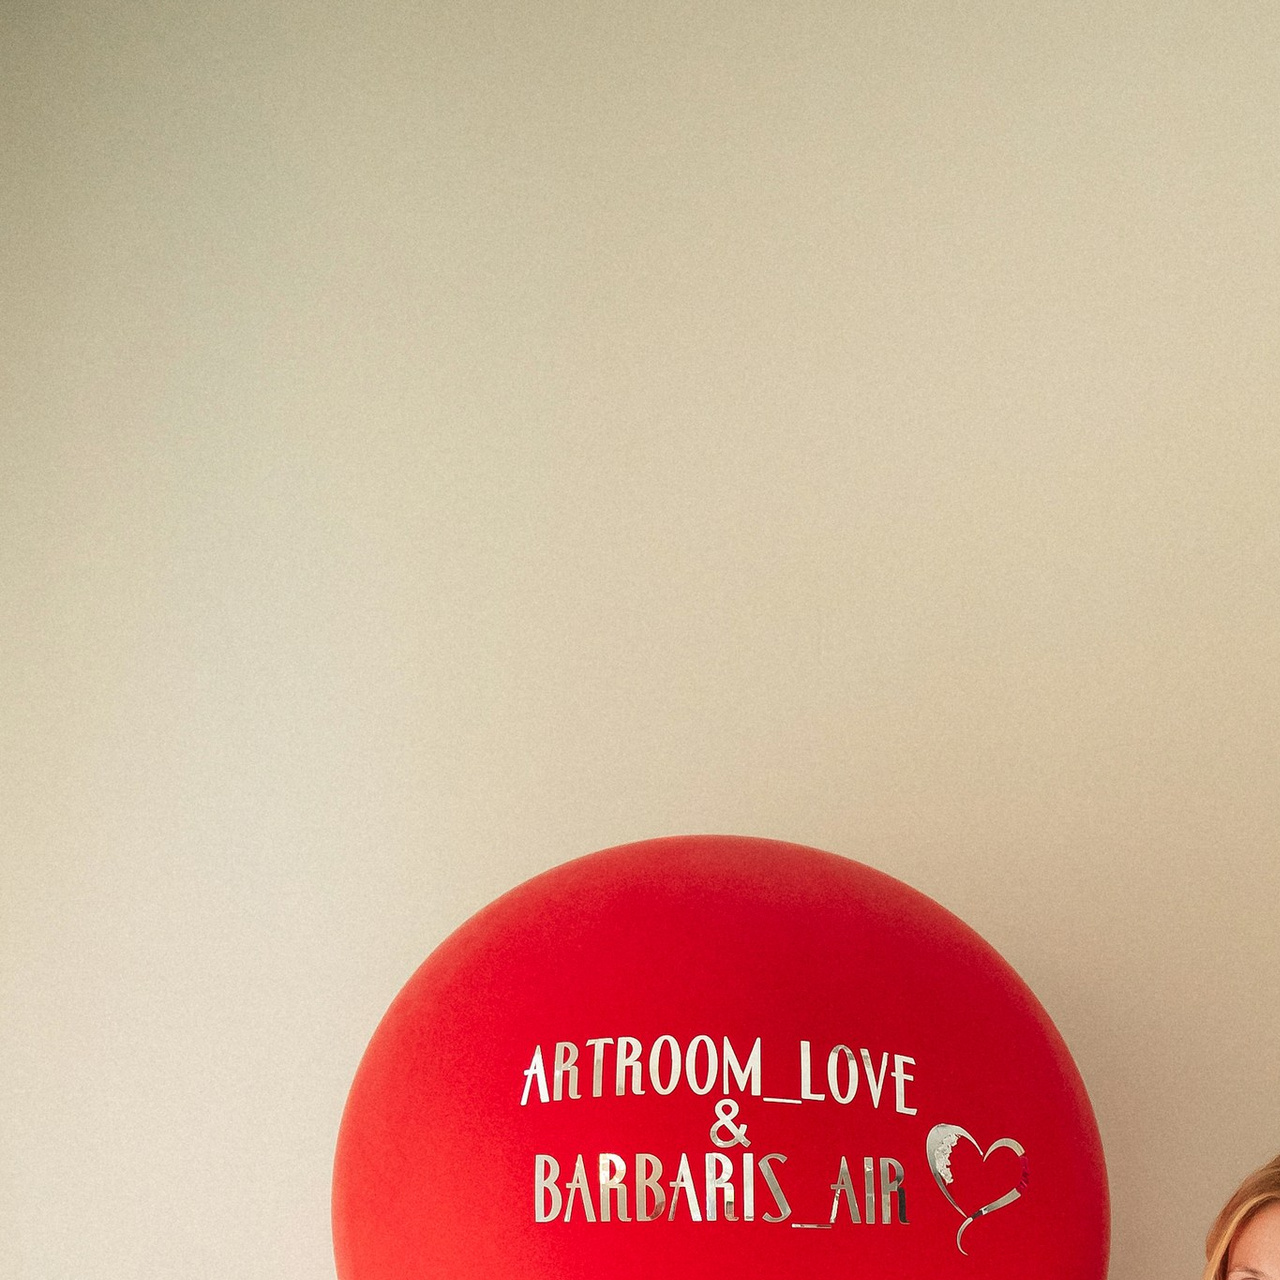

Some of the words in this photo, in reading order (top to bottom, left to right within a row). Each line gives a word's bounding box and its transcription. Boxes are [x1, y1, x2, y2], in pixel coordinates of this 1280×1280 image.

[520, 1034, 918, 1116] ARTROOM_LOVE
[709, 1098, 752, 1148] &
[534, 1152, 910, 1229] BARBARIS_AIR
